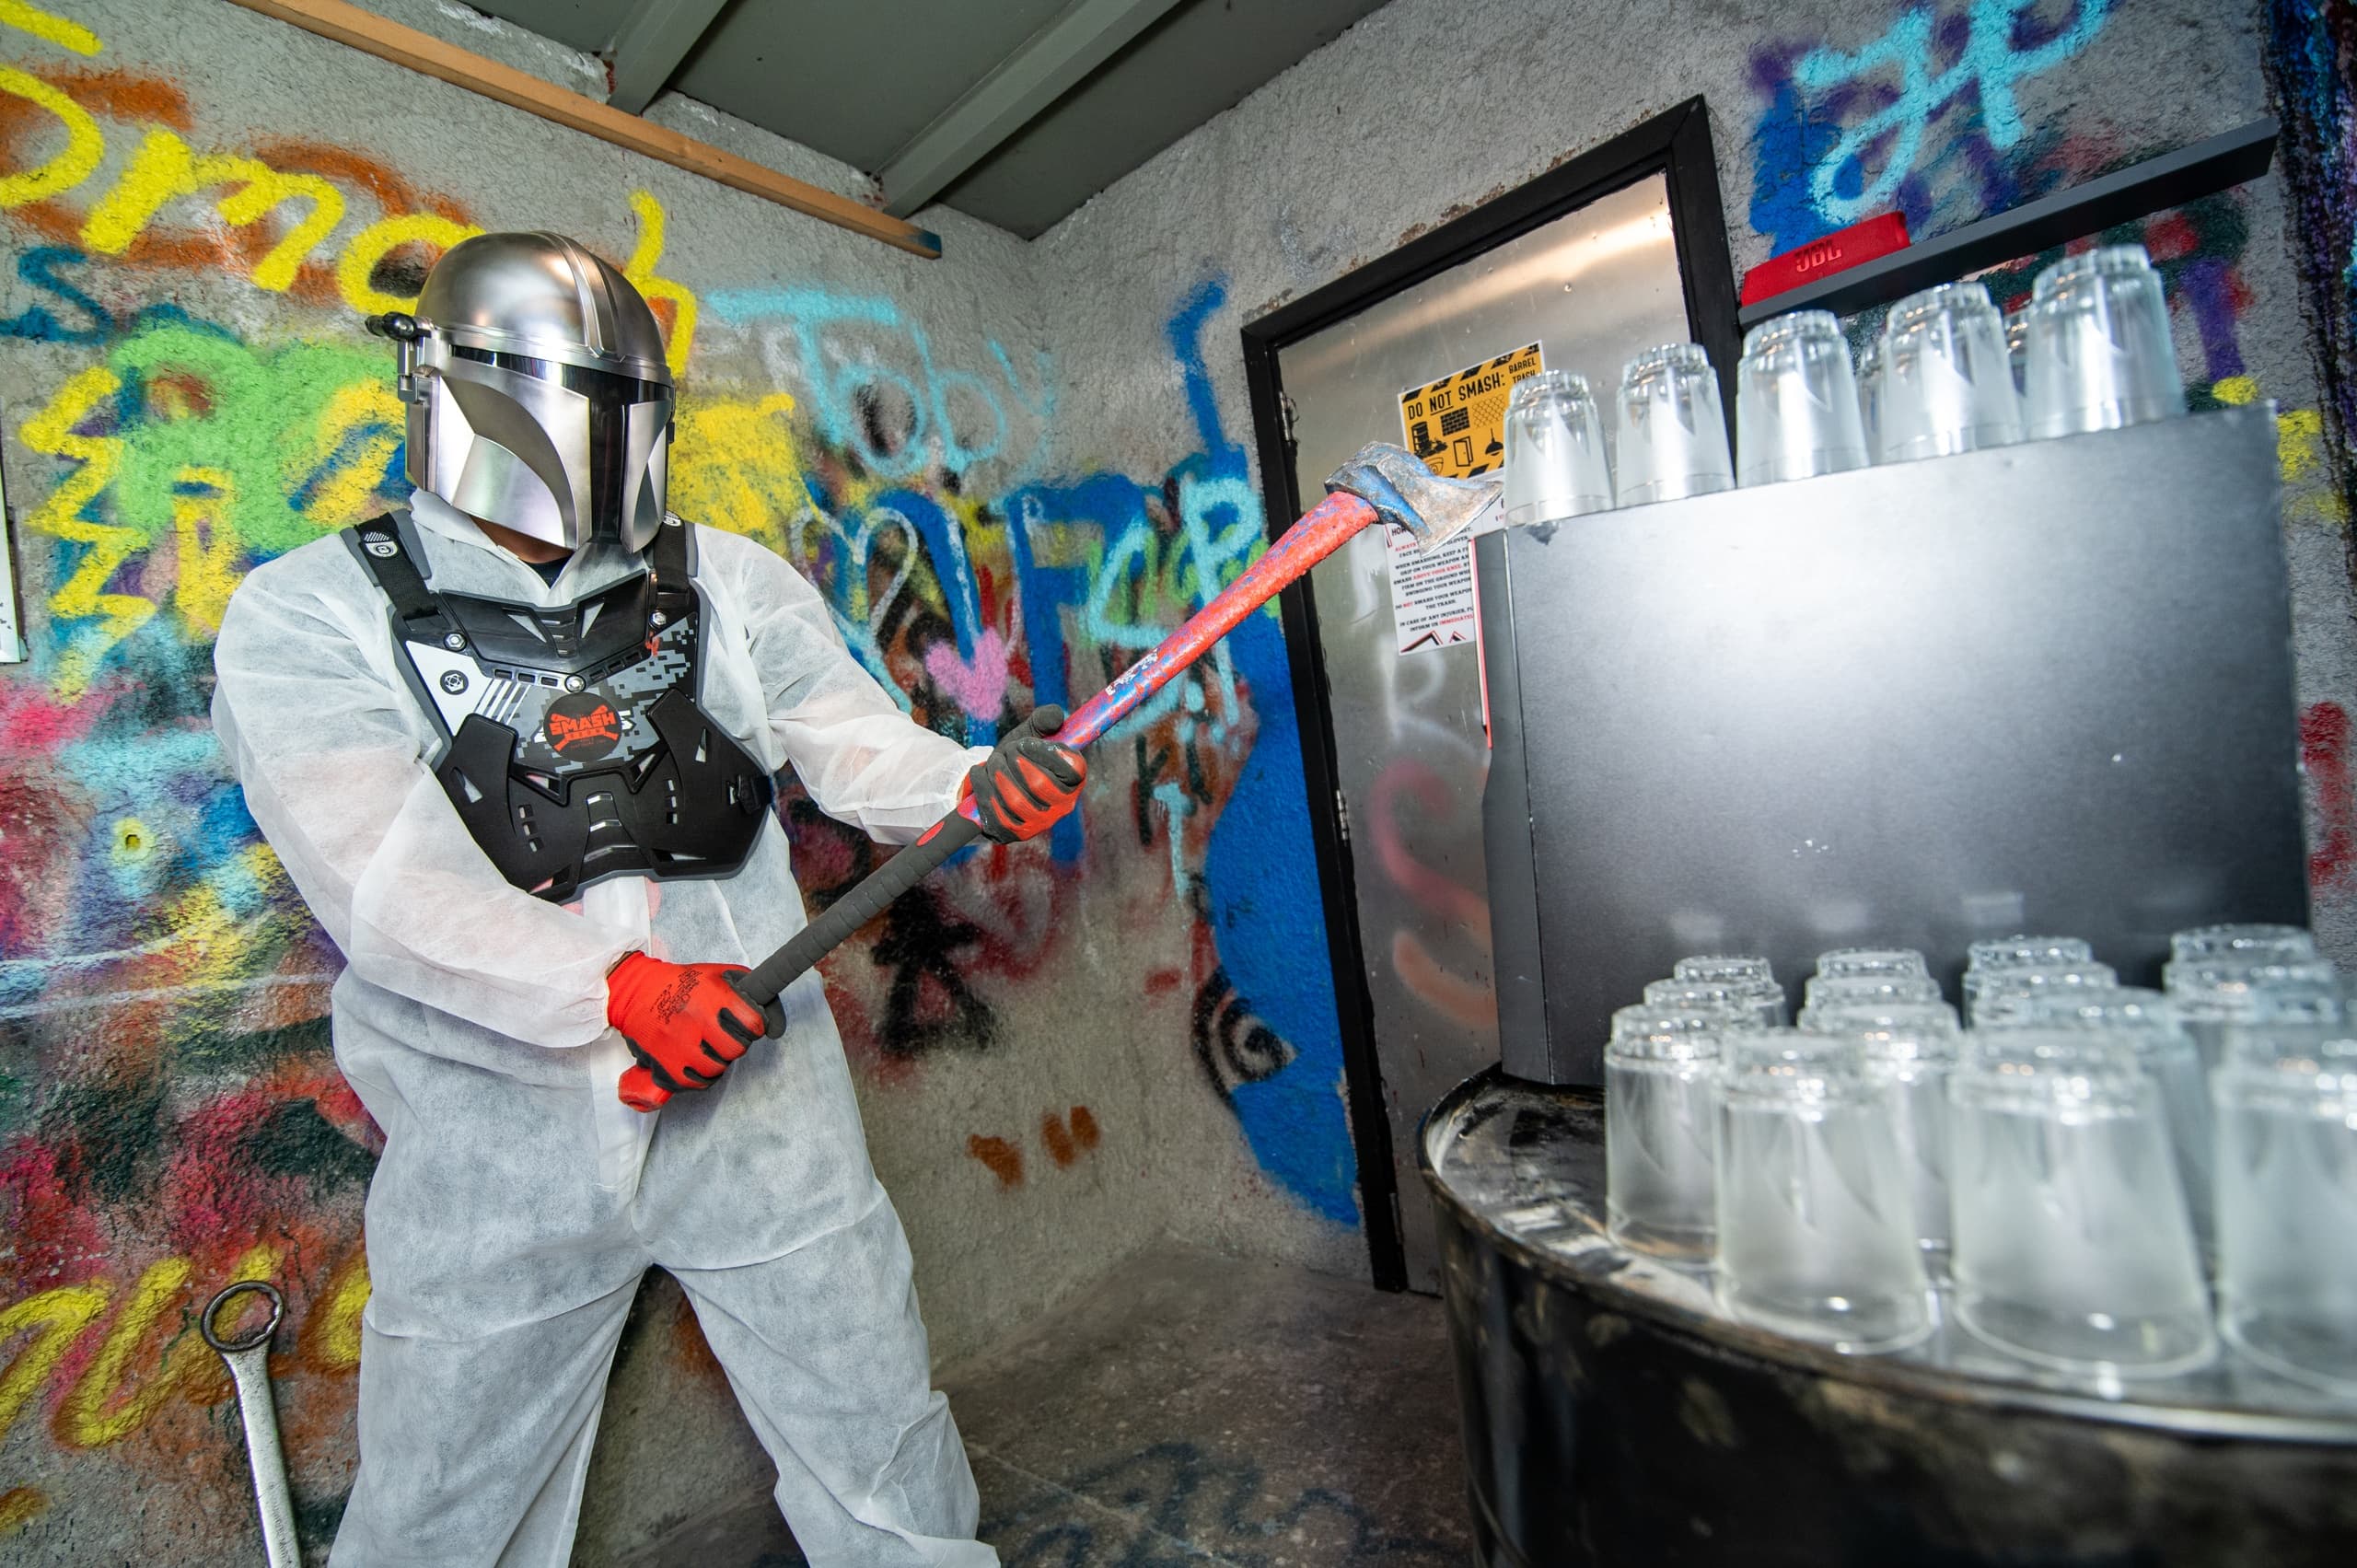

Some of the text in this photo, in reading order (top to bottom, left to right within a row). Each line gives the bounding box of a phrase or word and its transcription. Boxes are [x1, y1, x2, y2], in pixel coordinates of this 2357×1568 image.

[1795, 239, 1842, 273] JBL
[1508, 357, 1537, 374] BARREL
[1408, 371, 1505, 420] DO NOT SMASH:
[1437, 556, 1459, 566] WEAPON
[1394, 576, 1411, 585] SMASH
[1435, 573, 1457, 581] GROUND
[1406, 587, 1433, 597] SWINGING
[1414, 597, 1434, 605] SMASH
[549, 713, 617, 736] SMASH
